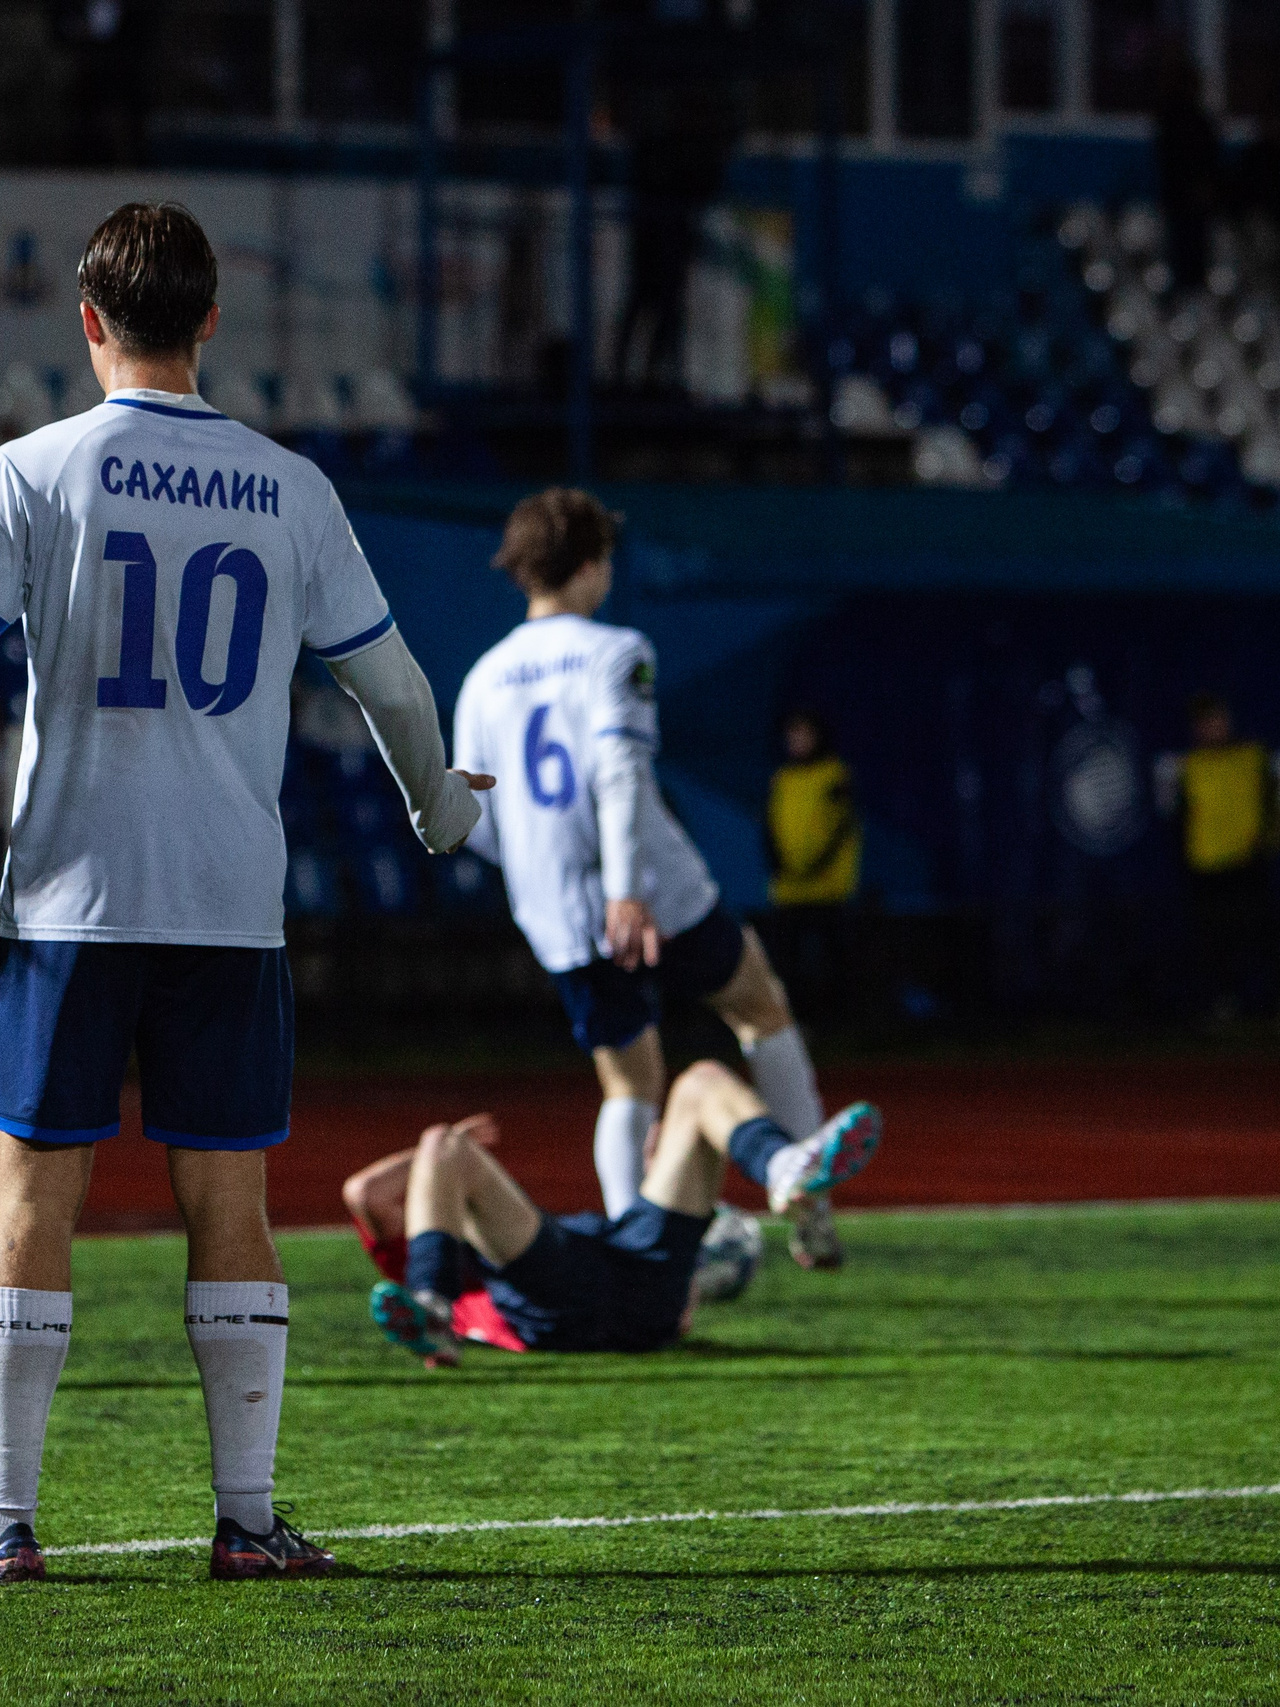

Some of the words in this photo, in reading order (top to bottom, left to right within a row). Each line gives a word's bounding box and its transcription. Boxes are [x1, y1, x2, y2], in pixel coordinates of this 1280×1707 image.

[100, 455, 279, 518] САХАЛИН
[97, 529, 268, 717] 10
[524, 703, 576, 809] 6
